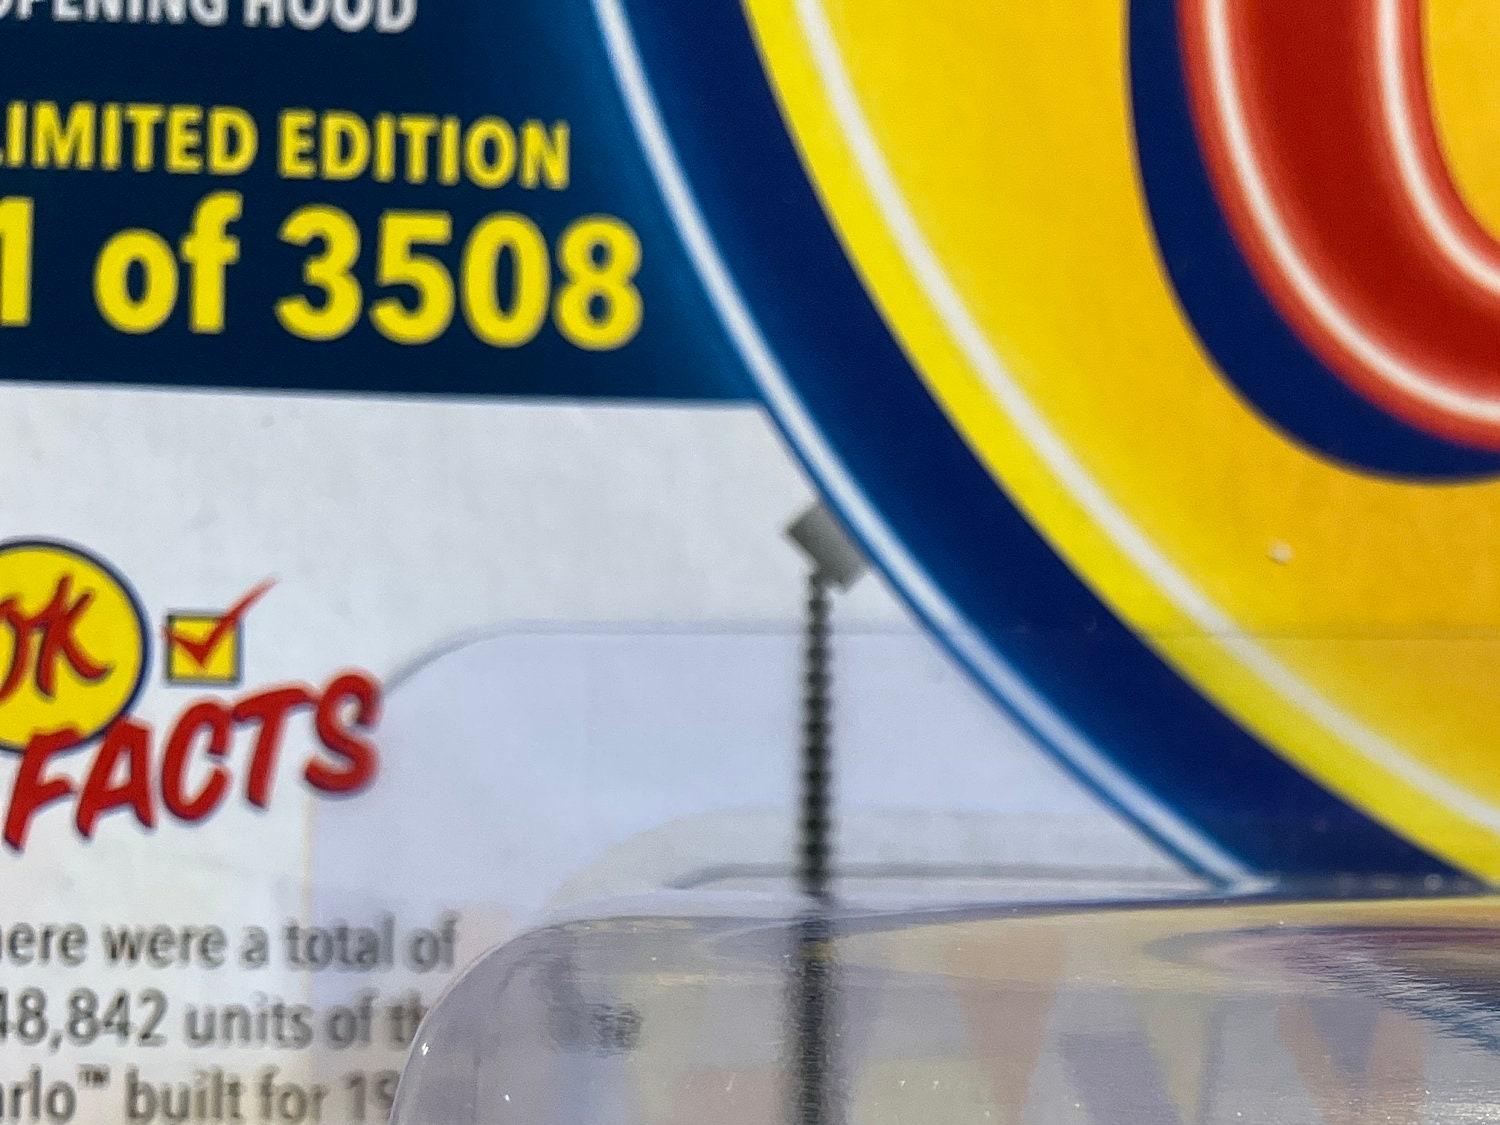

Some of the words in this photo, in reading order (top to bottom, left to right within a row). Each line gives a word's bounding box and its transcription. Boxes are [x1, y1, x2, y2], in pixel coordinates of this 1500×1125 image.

[0, 101, 258, 175] IMITED
[277, 108, 570, 189] EDITION
[93, 190, 243, 335] of
[275, 203, 643, 352] 3508
[3, 667, 382, 855] FACTS
[0, 920, 88, 968] ere
[100, 922, 227, 969] were
[239, 925, 270, 970] a
[282, 911, 396, 973] total
[406, 910, 459, 973] of
[184, 991, 314, 1050] units
[325, 986, 380, 1050] of
[0, 1062, 112, 1125] rlo™
